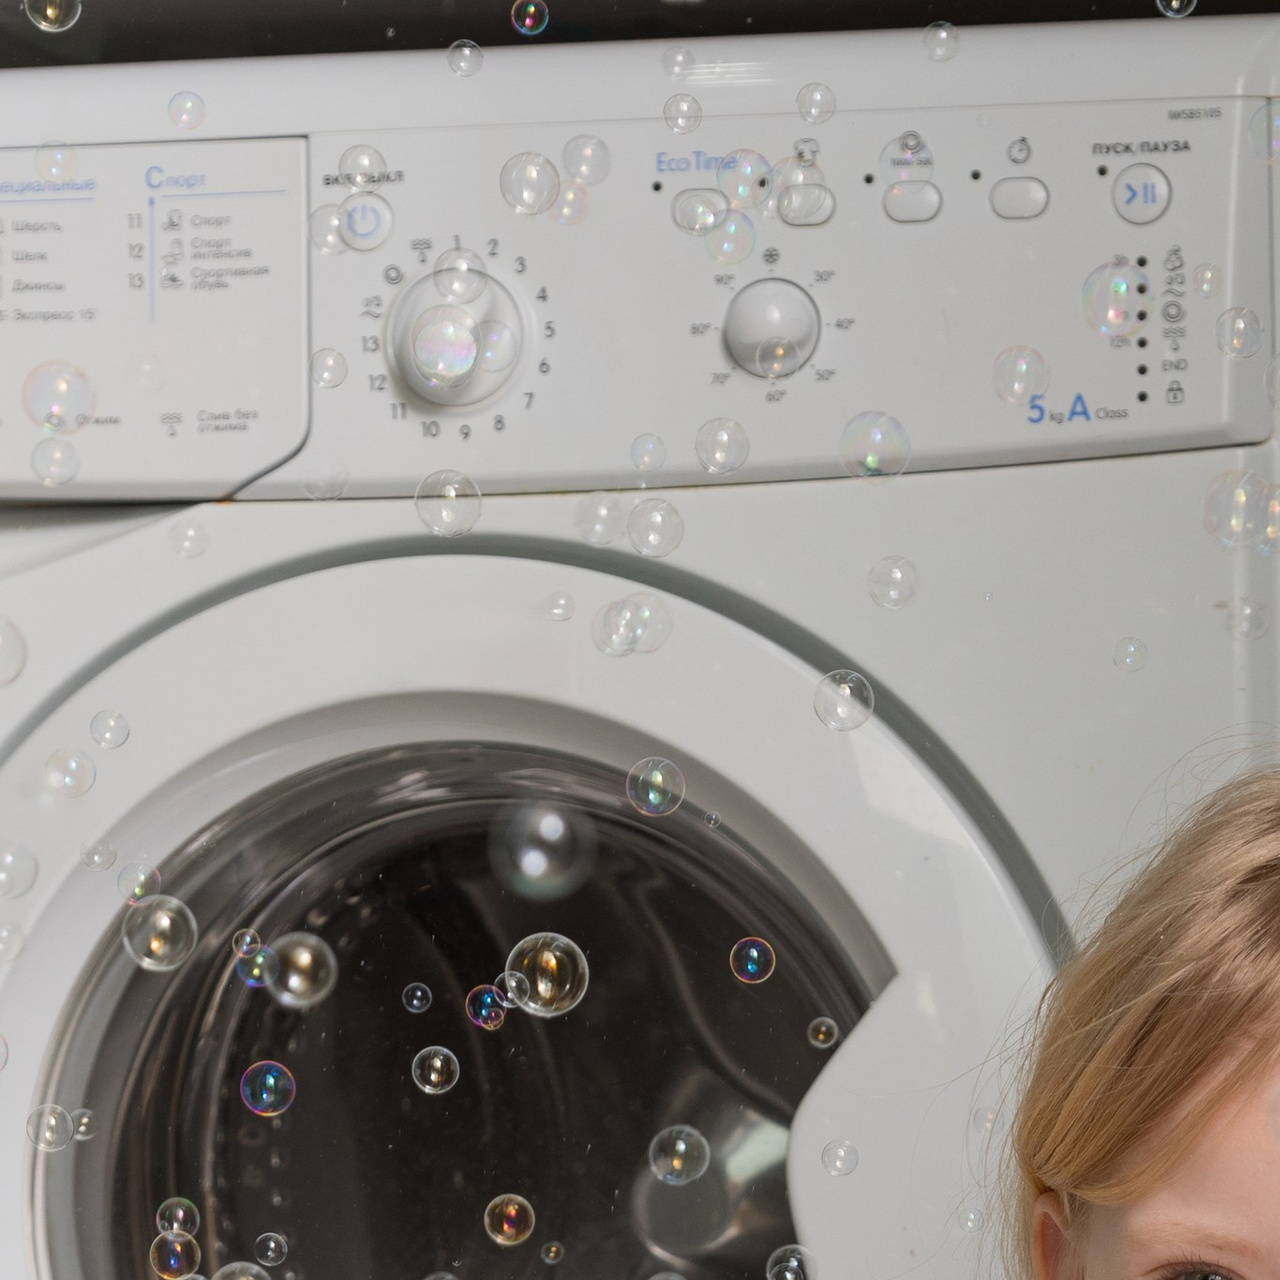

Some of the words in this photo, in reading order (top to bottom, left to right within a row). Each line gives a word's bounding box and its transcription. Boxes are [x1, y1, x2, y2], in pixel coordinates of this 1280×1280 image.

[128, 213, 142, 228] 11
[128, 243, 144, 259] 12
[487, 239, 499, 256] 2
[515, 257, 526, 273] 3
[128, 272, 144, 288] 13
[536, 286, 548, 301] 4
[544, 322, 556, 338] 5
[361, 336, 380, 351] 13
[539, 358, 550, 375] 6
[1162, 358, 1188, 371] END
[368, 375, 386, 390] 12
[524, 393, 535, 409] 7
[1027, 394, 1045, 423] 5
[1049, 411, 1064, 424] kg
[1095, 407, 1129, 419] Class
[390, 402, 407, 419] 11
[421, 422, 439, 437] 10
[493, 415, 505, 431] 8
[459, 425, 471, 439] 9
